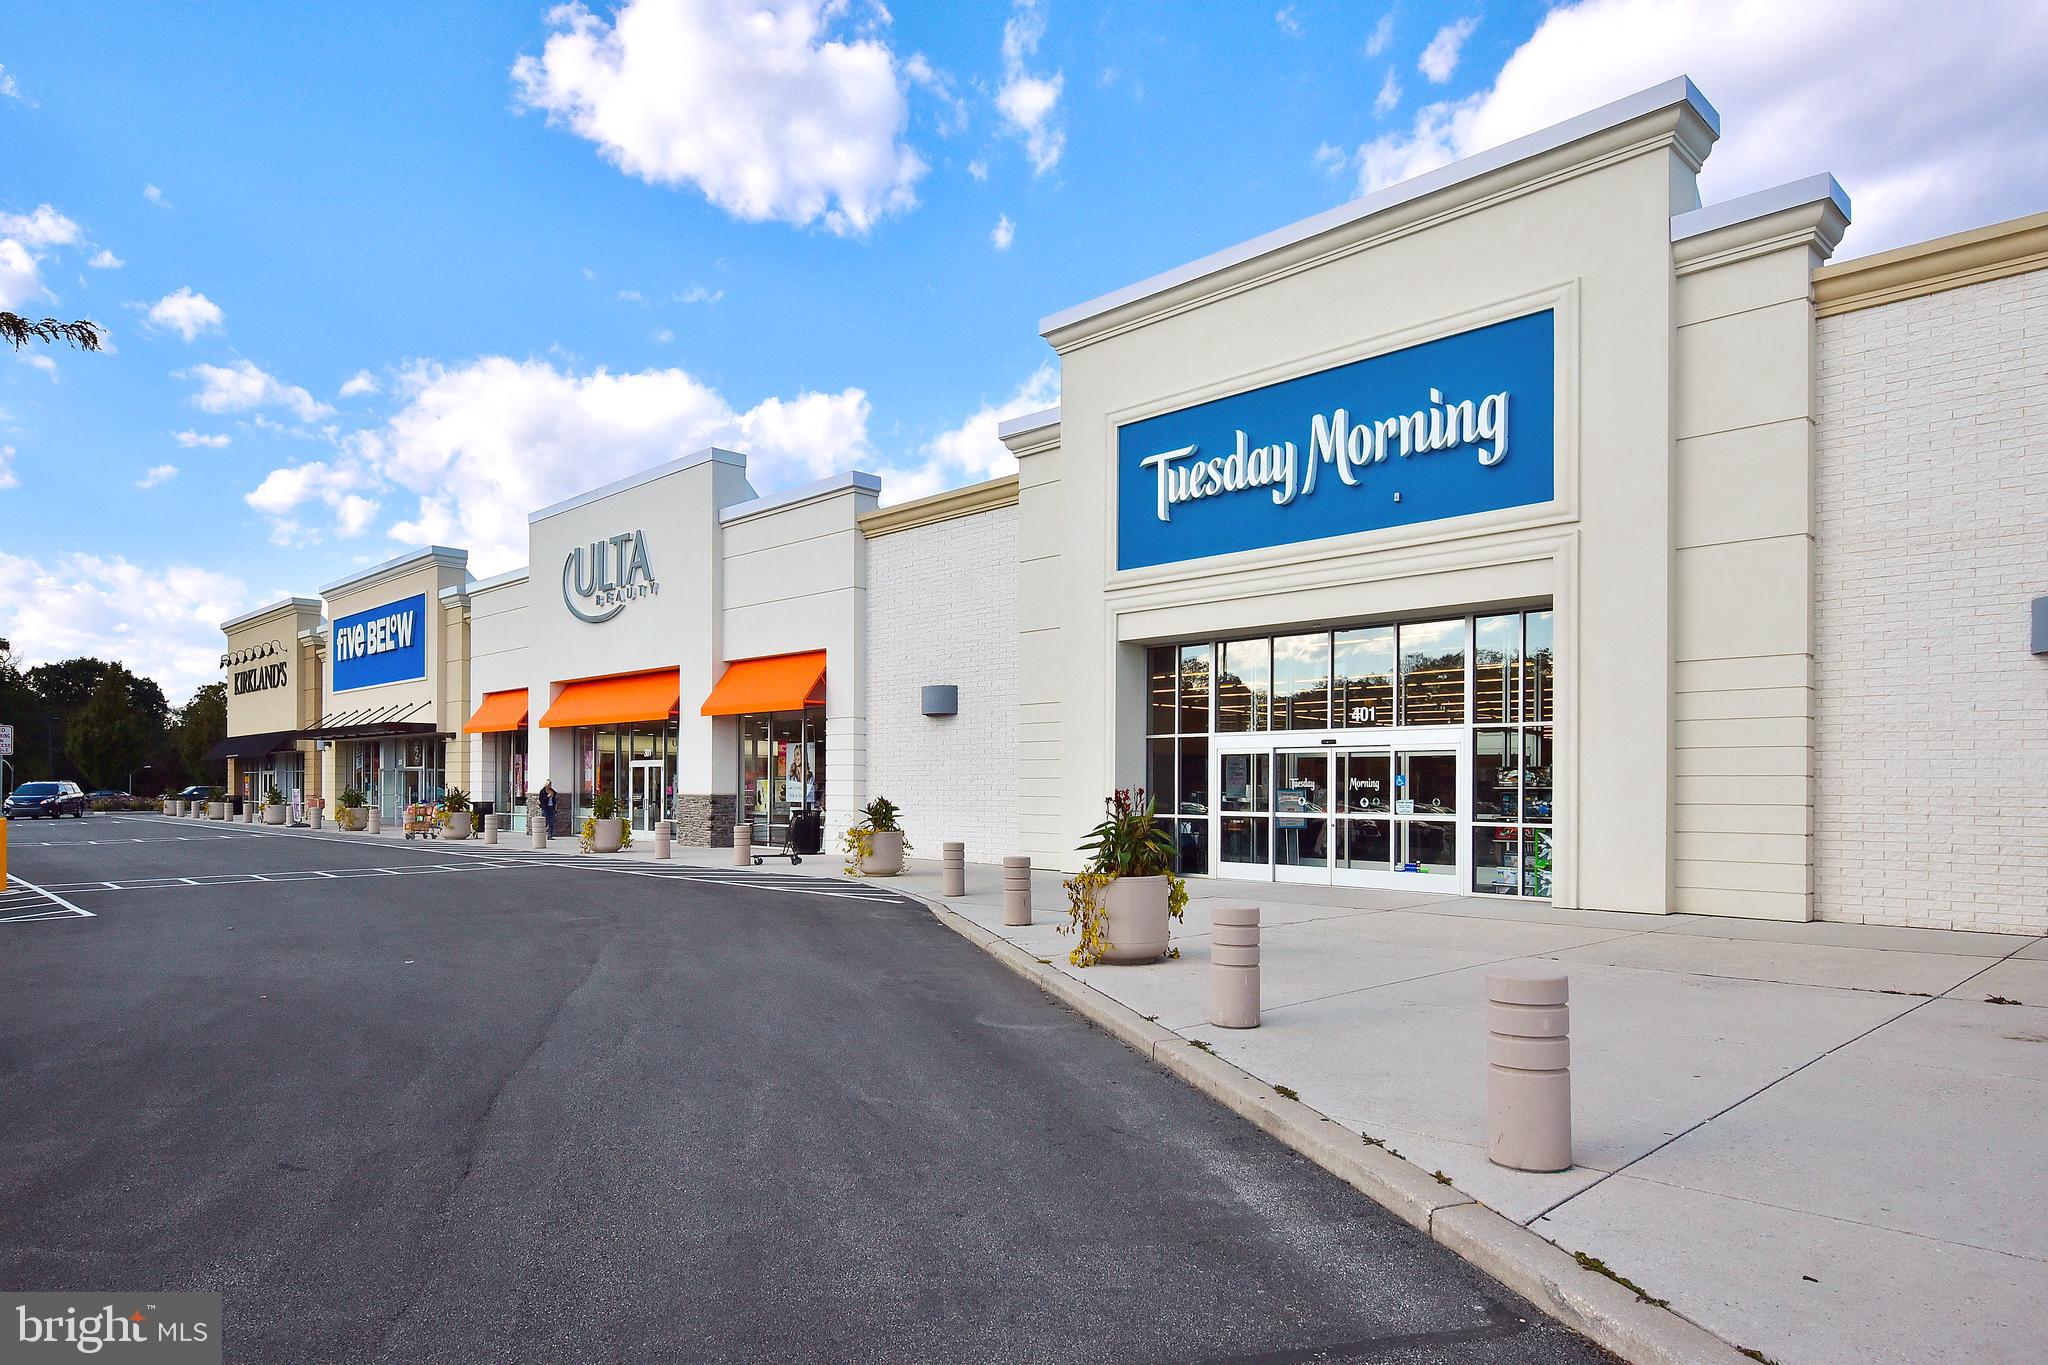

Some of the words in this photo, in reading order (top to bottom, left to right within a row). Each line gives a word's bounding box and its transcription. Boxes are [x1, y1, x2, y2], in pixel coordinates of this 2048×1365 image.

[1139, 430, 1297, 522] Tuesday
[1301, 387, 1510, 495] Morning
[574, 529, 655, 597] ULTA
[595, 582, 659, 607] BEAUTY
[336, 624, 366, 661] five
[367, 610, 414, 655] BELOW
[233, 661, 288, 695] KIRKLAND'S
[1352, 706, 1375, 722] 401
[643, 748, 652, 758] 301
[1289, 777, 1316, 791] Tuesday
[1349, 777, 1380, 792] Morning
